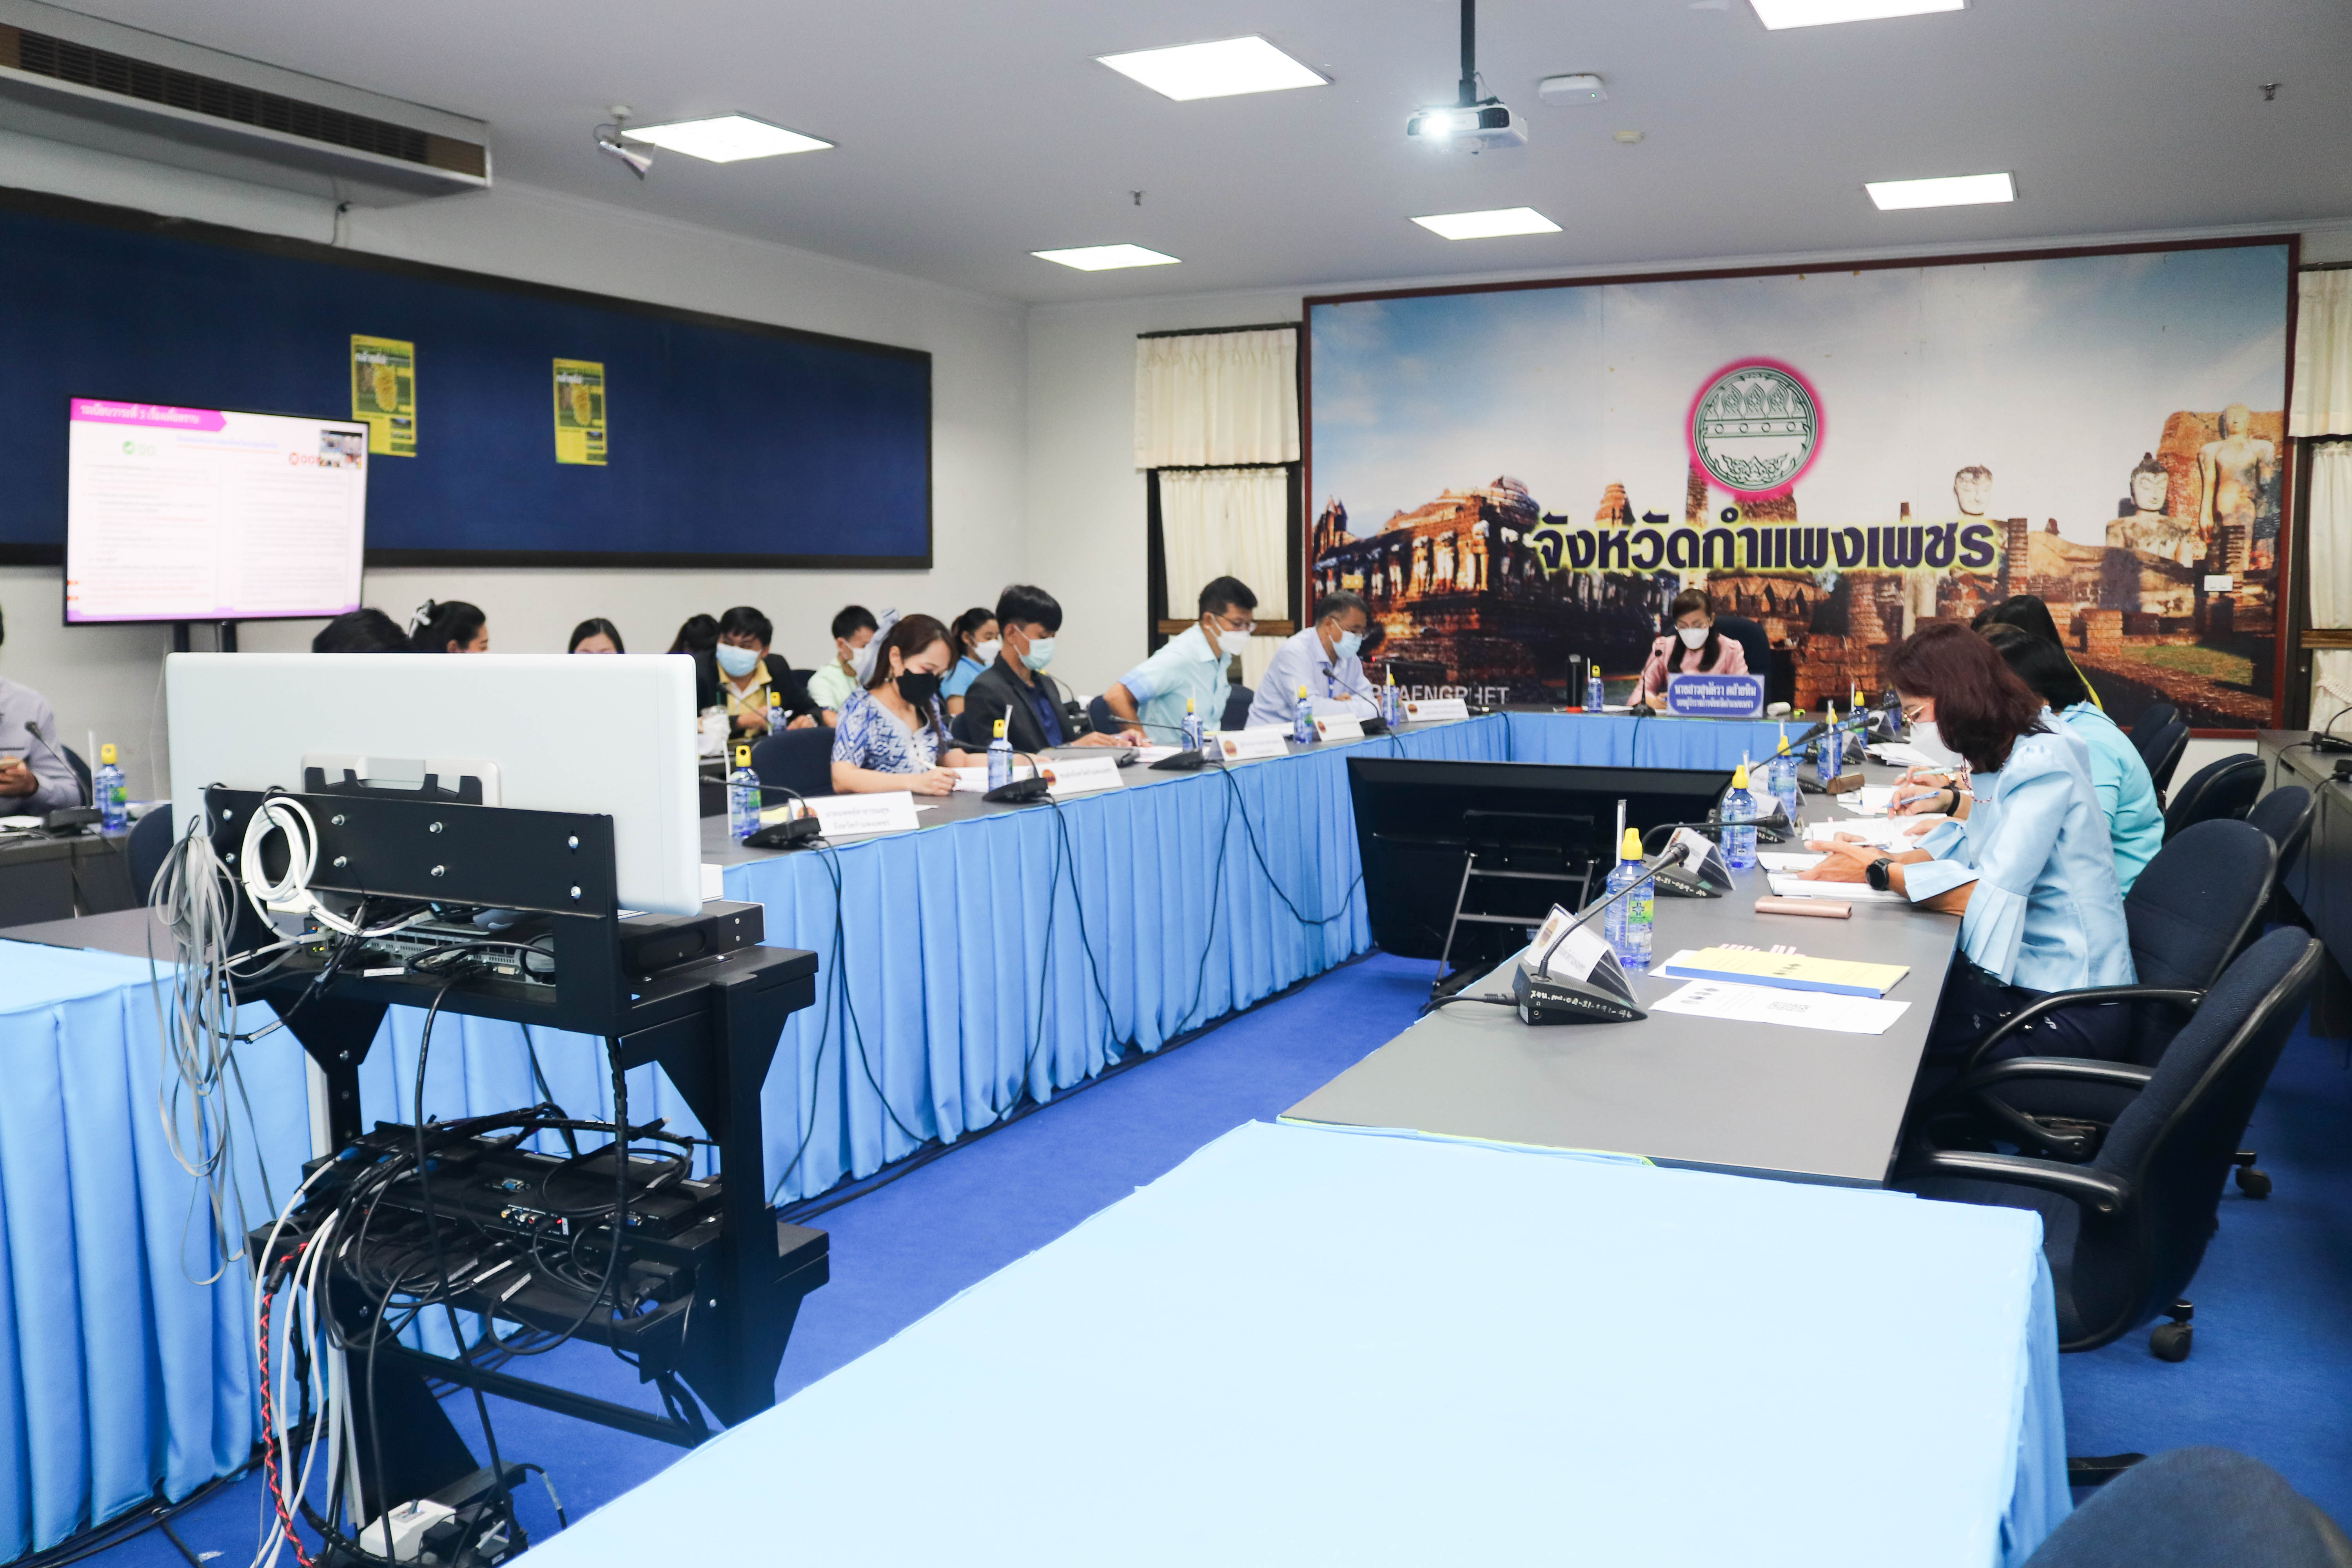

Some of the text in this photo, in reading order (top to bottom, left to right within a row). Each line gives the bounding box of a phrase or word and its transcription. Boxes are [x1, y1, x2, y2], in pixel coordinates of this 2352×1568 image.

[1533, 507, 1994, 569] จังหวัดกำแพงเพชร
